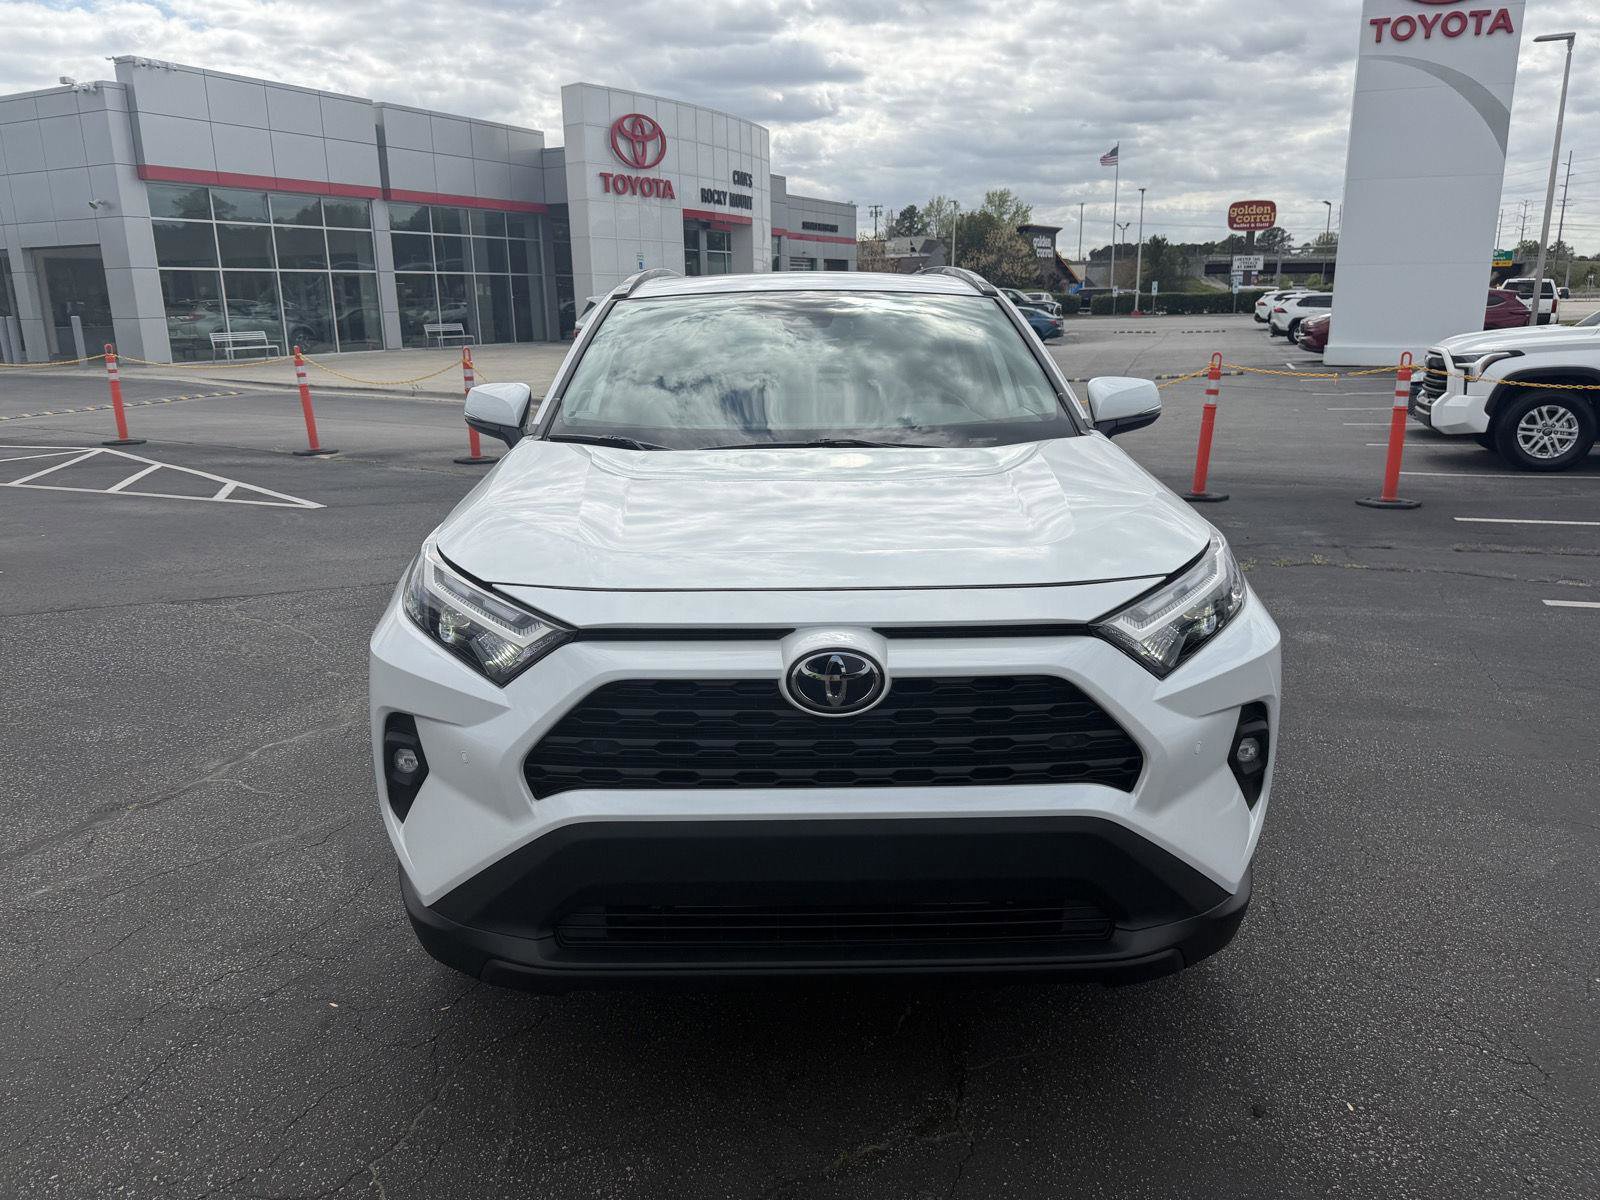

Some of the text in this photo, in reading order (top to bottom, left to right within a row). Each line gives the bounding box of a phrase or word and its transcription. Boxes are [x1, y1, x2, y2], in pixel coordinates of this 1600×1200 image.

[1369, 8, 1514, 43] TOYOTA
[599, 172, 675, 199] TOYOTA
[700, 188, 728, 206] ROCKY
[729, 192, 753, 211] MOUNT
[1230, 205, 1271, 217] golden
[1235, 212, 1275, 222] corral
